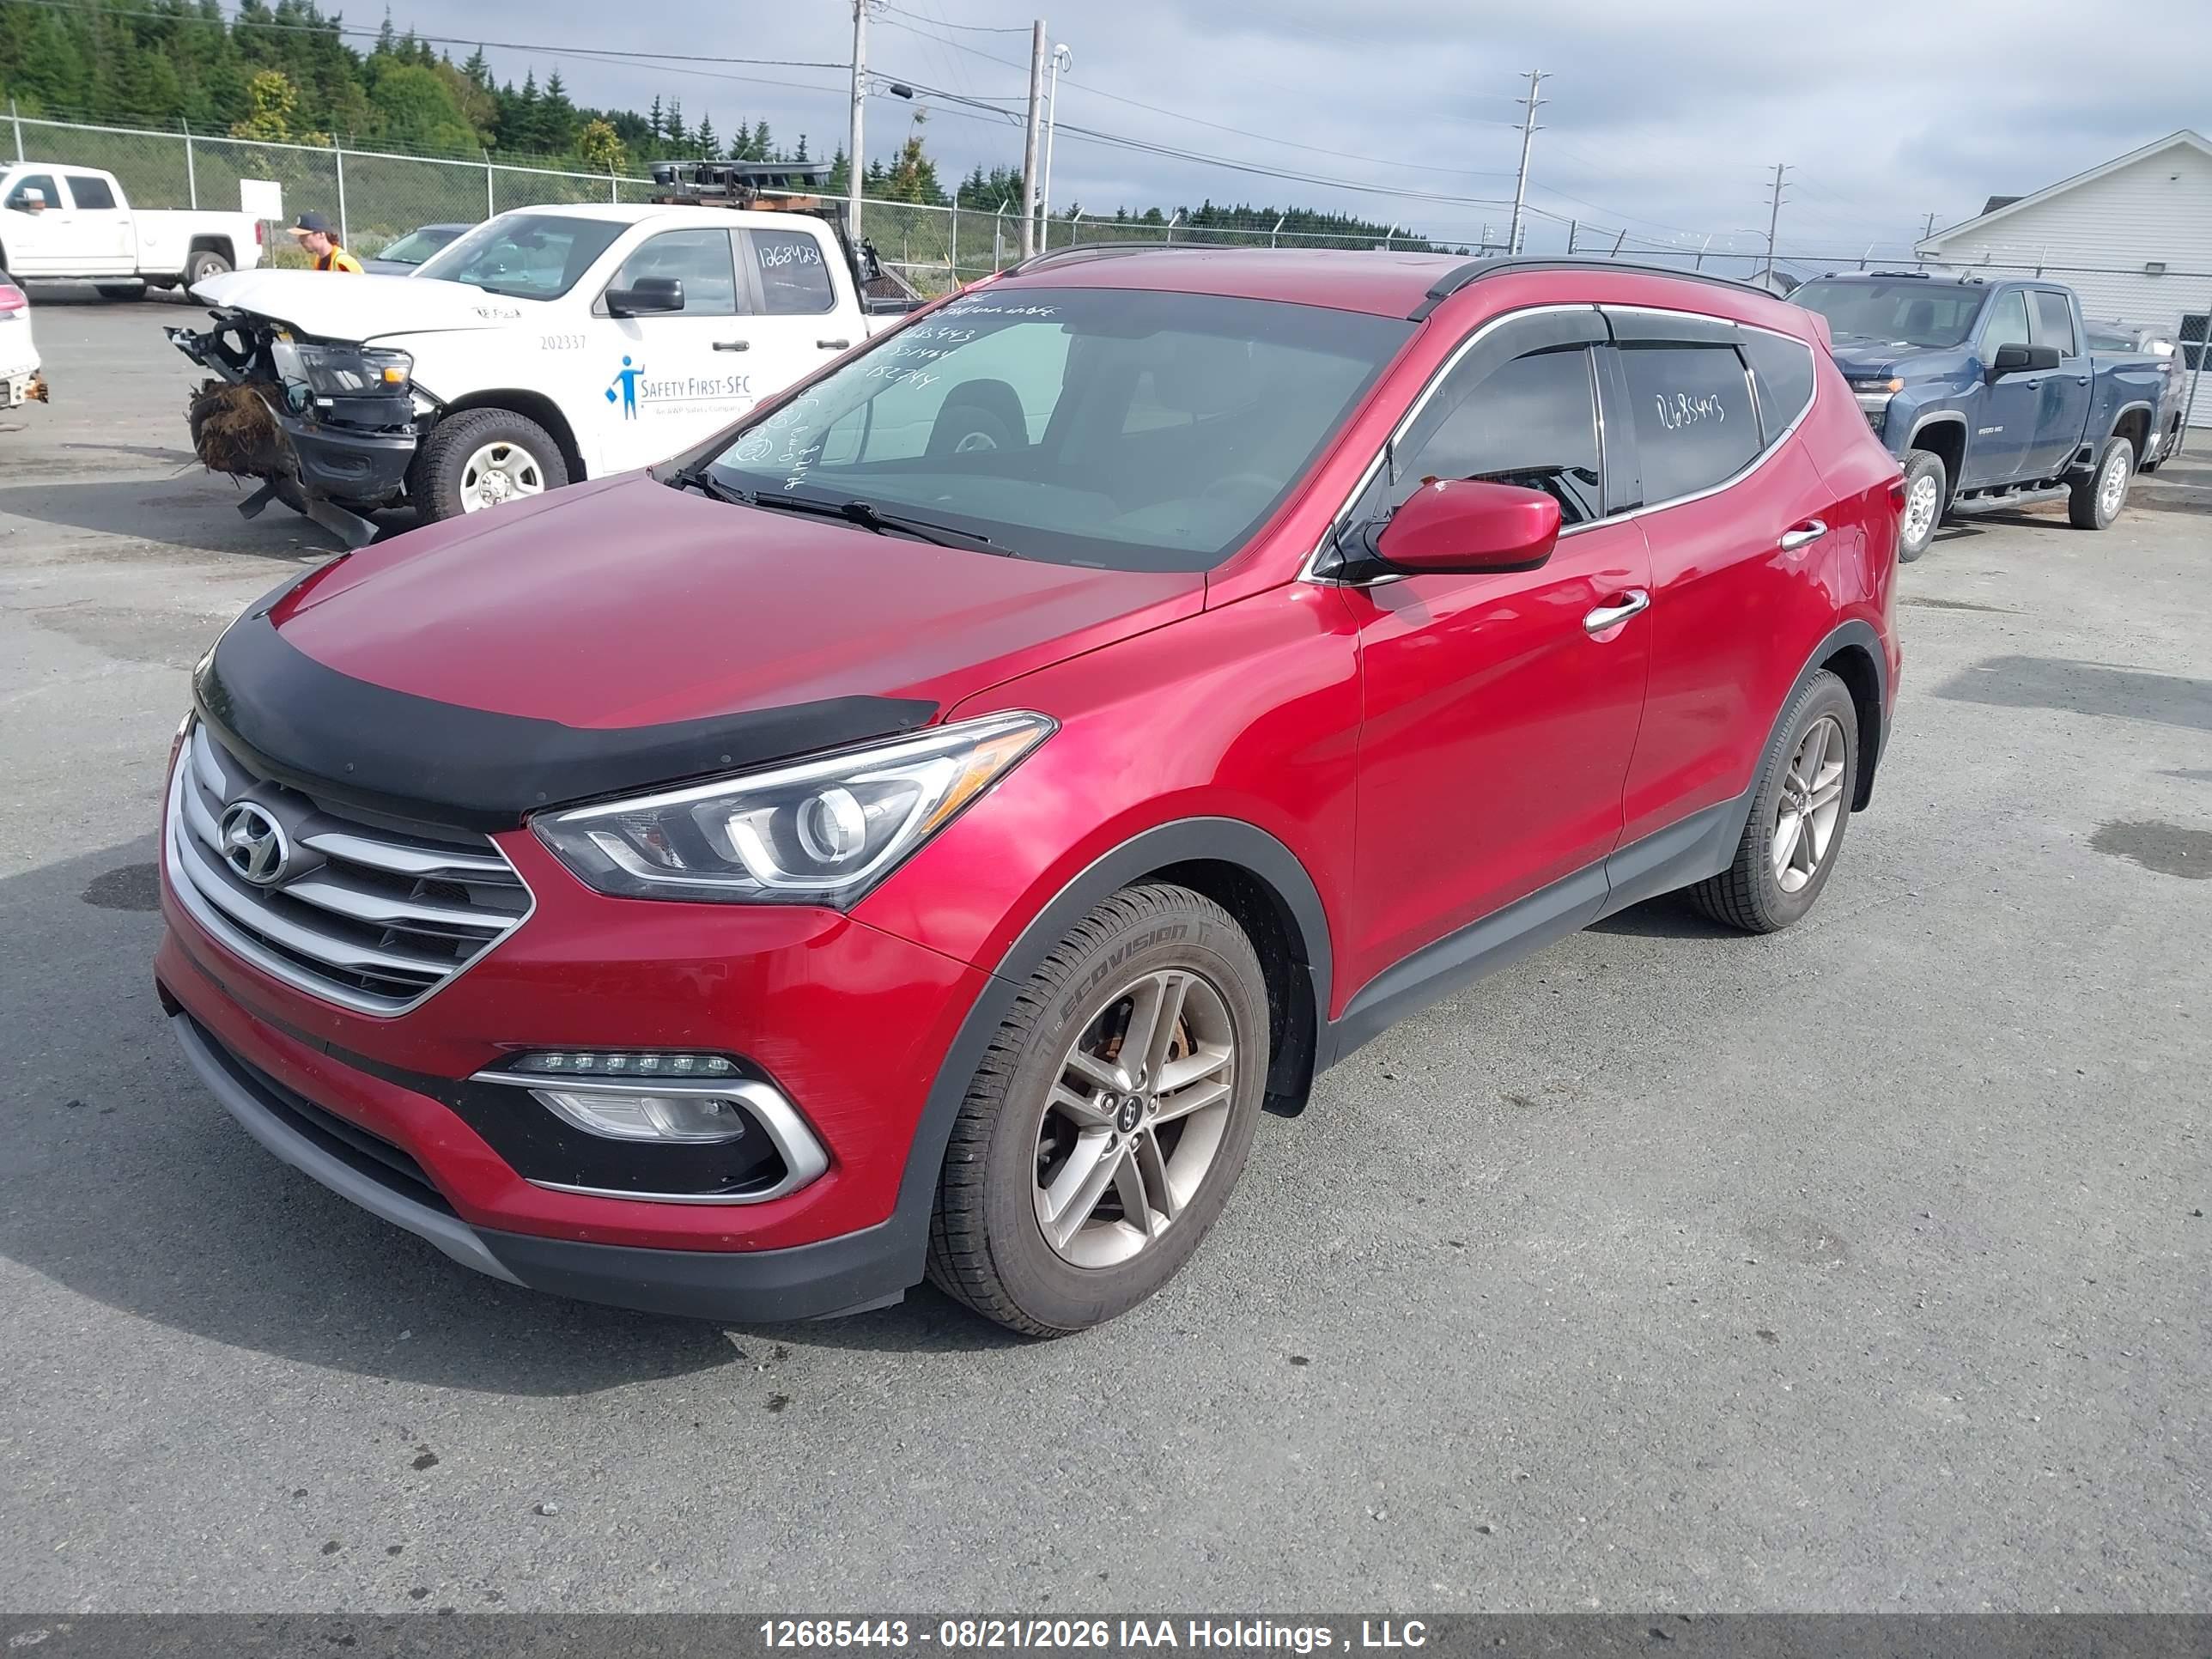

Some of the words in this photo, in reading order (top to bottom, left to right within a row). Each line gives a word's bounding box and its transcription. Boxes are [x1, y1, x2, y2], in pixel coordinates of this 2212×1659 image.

[759, 245, 822, 268] 12684231
[539, 335, 586, 349] 202337
[641, 380, 685, 398] SAFETY
[688, 375, 751, 396] FIRST-SFC
[1059, 924, 1188, 1024] ECOVISION
